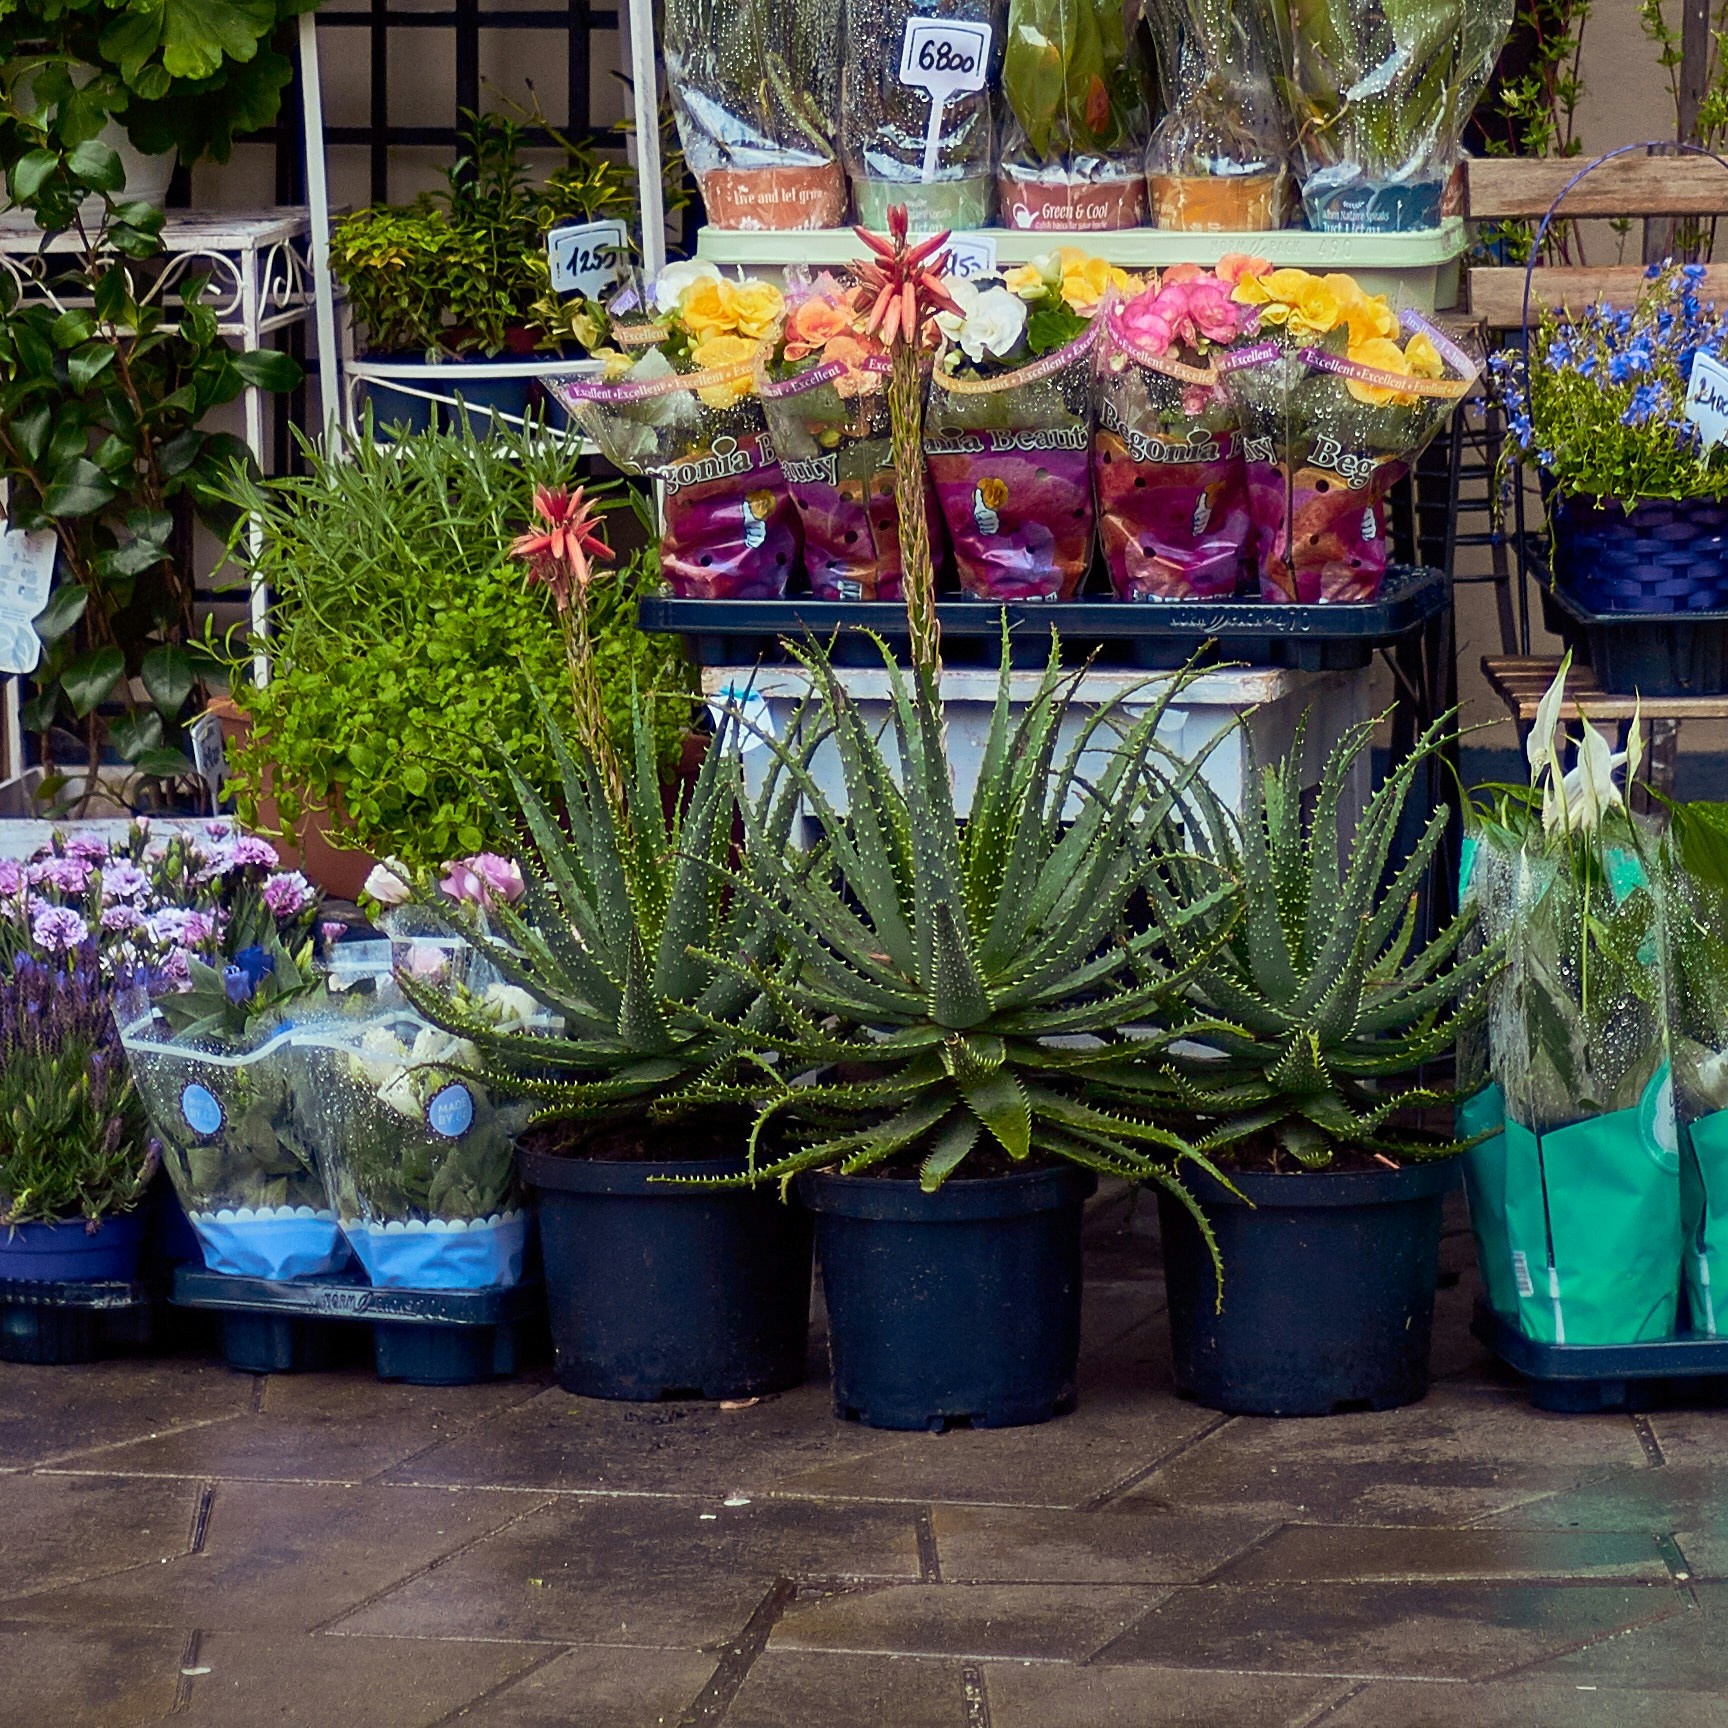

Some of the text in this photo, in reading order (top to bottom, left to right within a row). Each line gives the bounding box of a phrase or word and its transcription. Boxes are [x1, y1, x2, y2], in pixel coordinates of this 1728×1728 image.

[919, 39, 975, 74] 6800
[1042, 202, 1109, 219] Green & Cool
[566, 241, 617, 277] 1250
[623, 327, 669, 342] Excellent
[1019, 356, 1067, 385] Excellent
[1123, 340, 1165, 372] Excellent
[1231, 347, 1274, 368] Excellent
[1305, 349, 1356, 378] Excellent
[1360, 368, 1406, 390] Excellent
[617, 378, 667, 400] Excellent
[792, 364, 841, 393] Excellent
